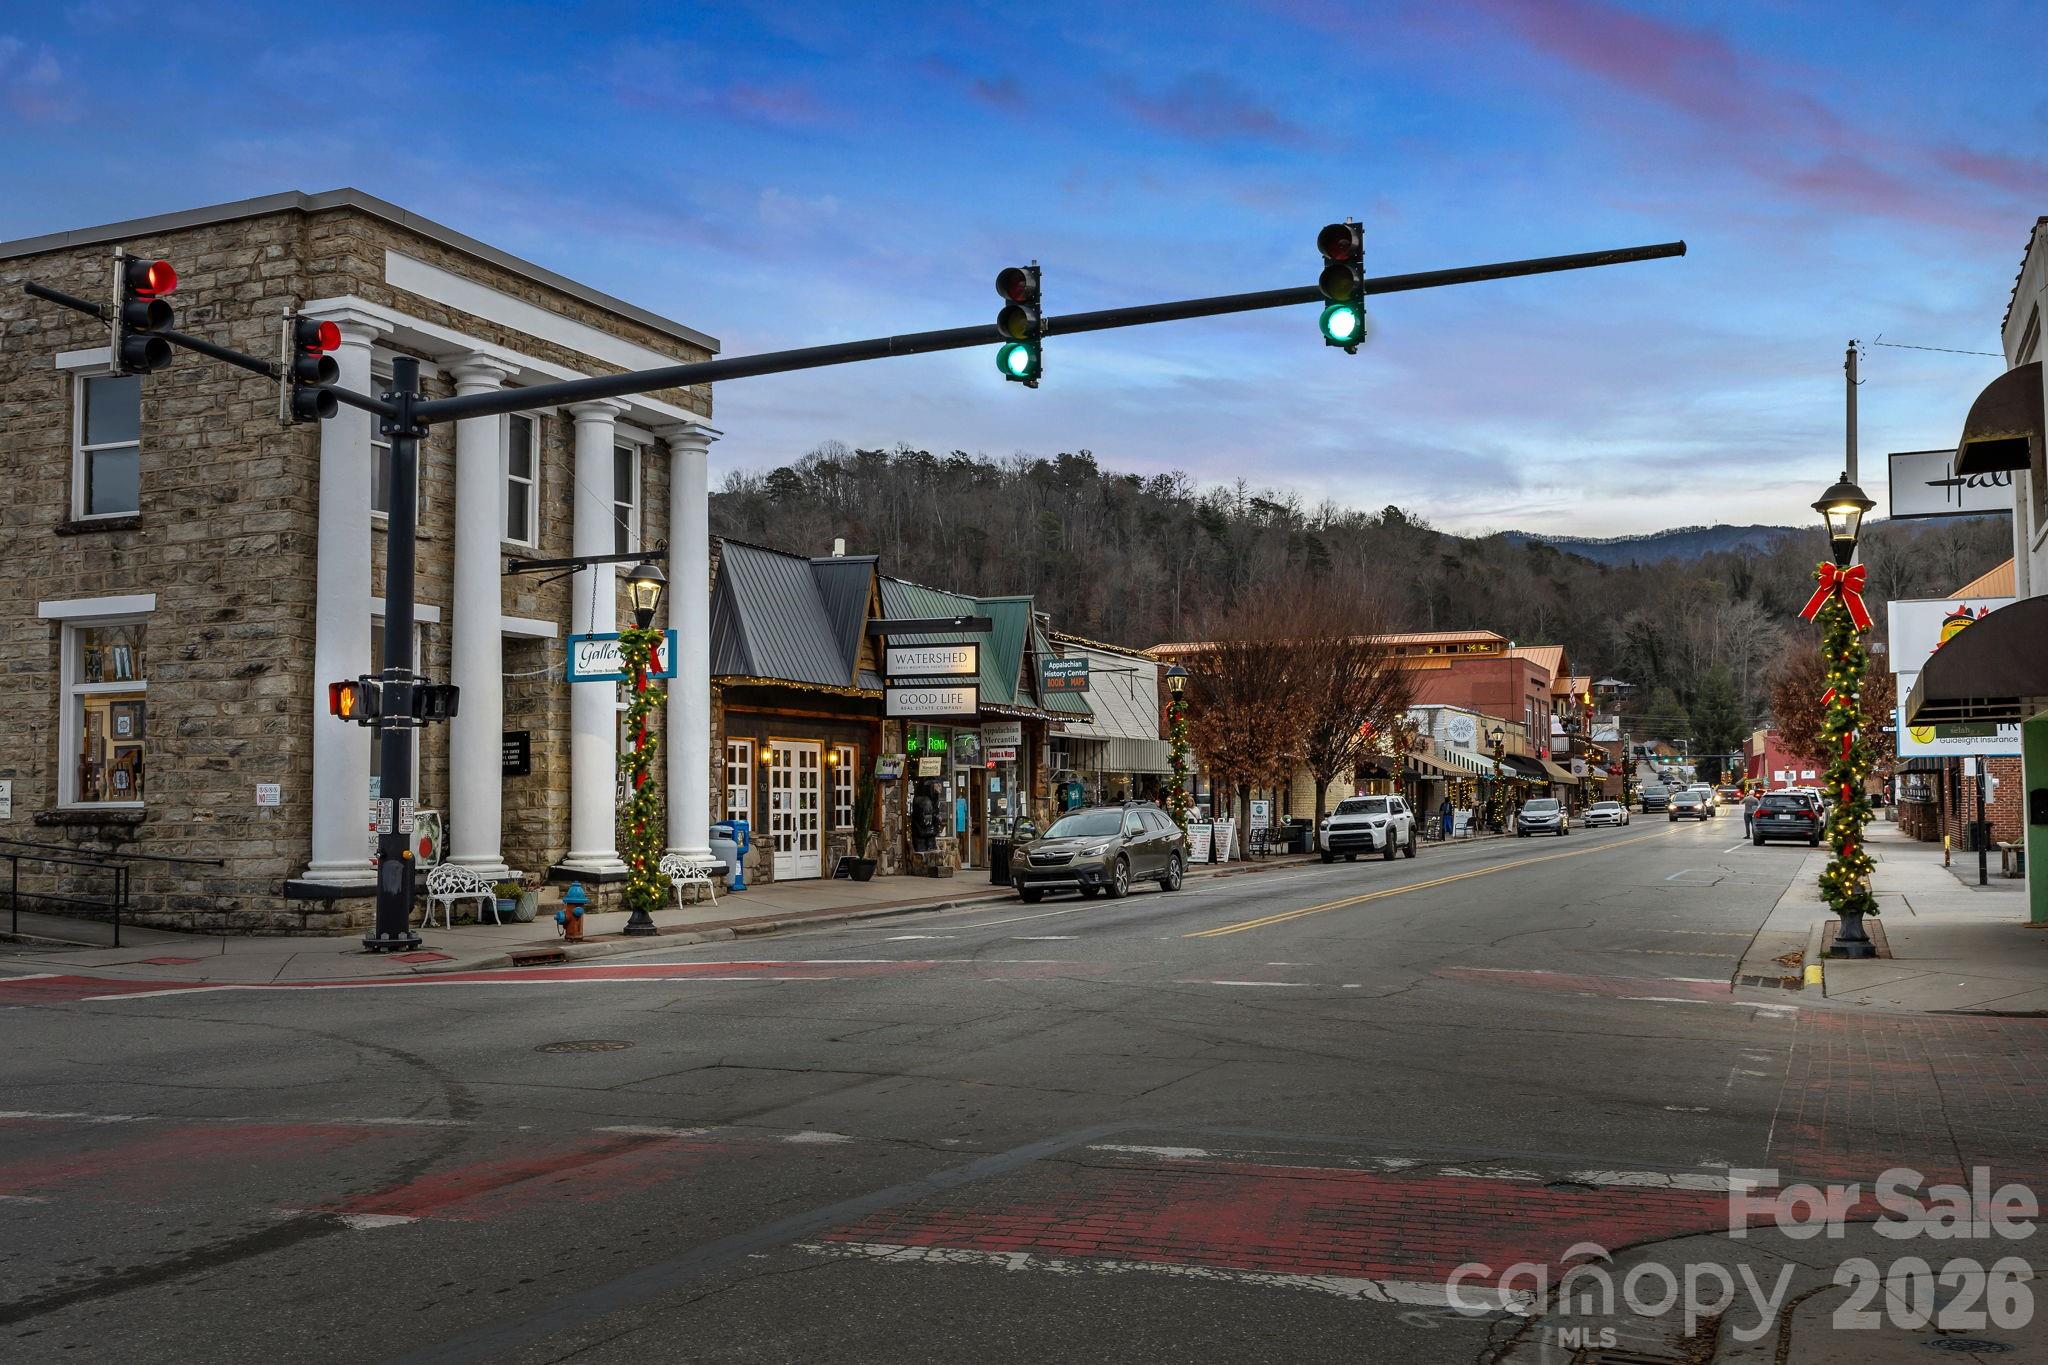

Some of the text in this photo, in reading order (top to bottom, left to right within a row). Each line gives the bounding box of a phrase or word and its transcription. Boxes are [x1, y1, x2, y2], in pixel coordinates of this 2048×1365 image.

[895, 652, 967, 665] WATERSHED
[1048, 660, 1083, 669] Appalachian
[1044, 669, 1088, 678] History Center
[1047, 677, 1086, 688] BOOKS MAPS
[899, 693, 964, 704] GOOD LIFE
[984, 726, 1019, 736] Appalachian
[984, 735, 1018, 744] Mercantile
